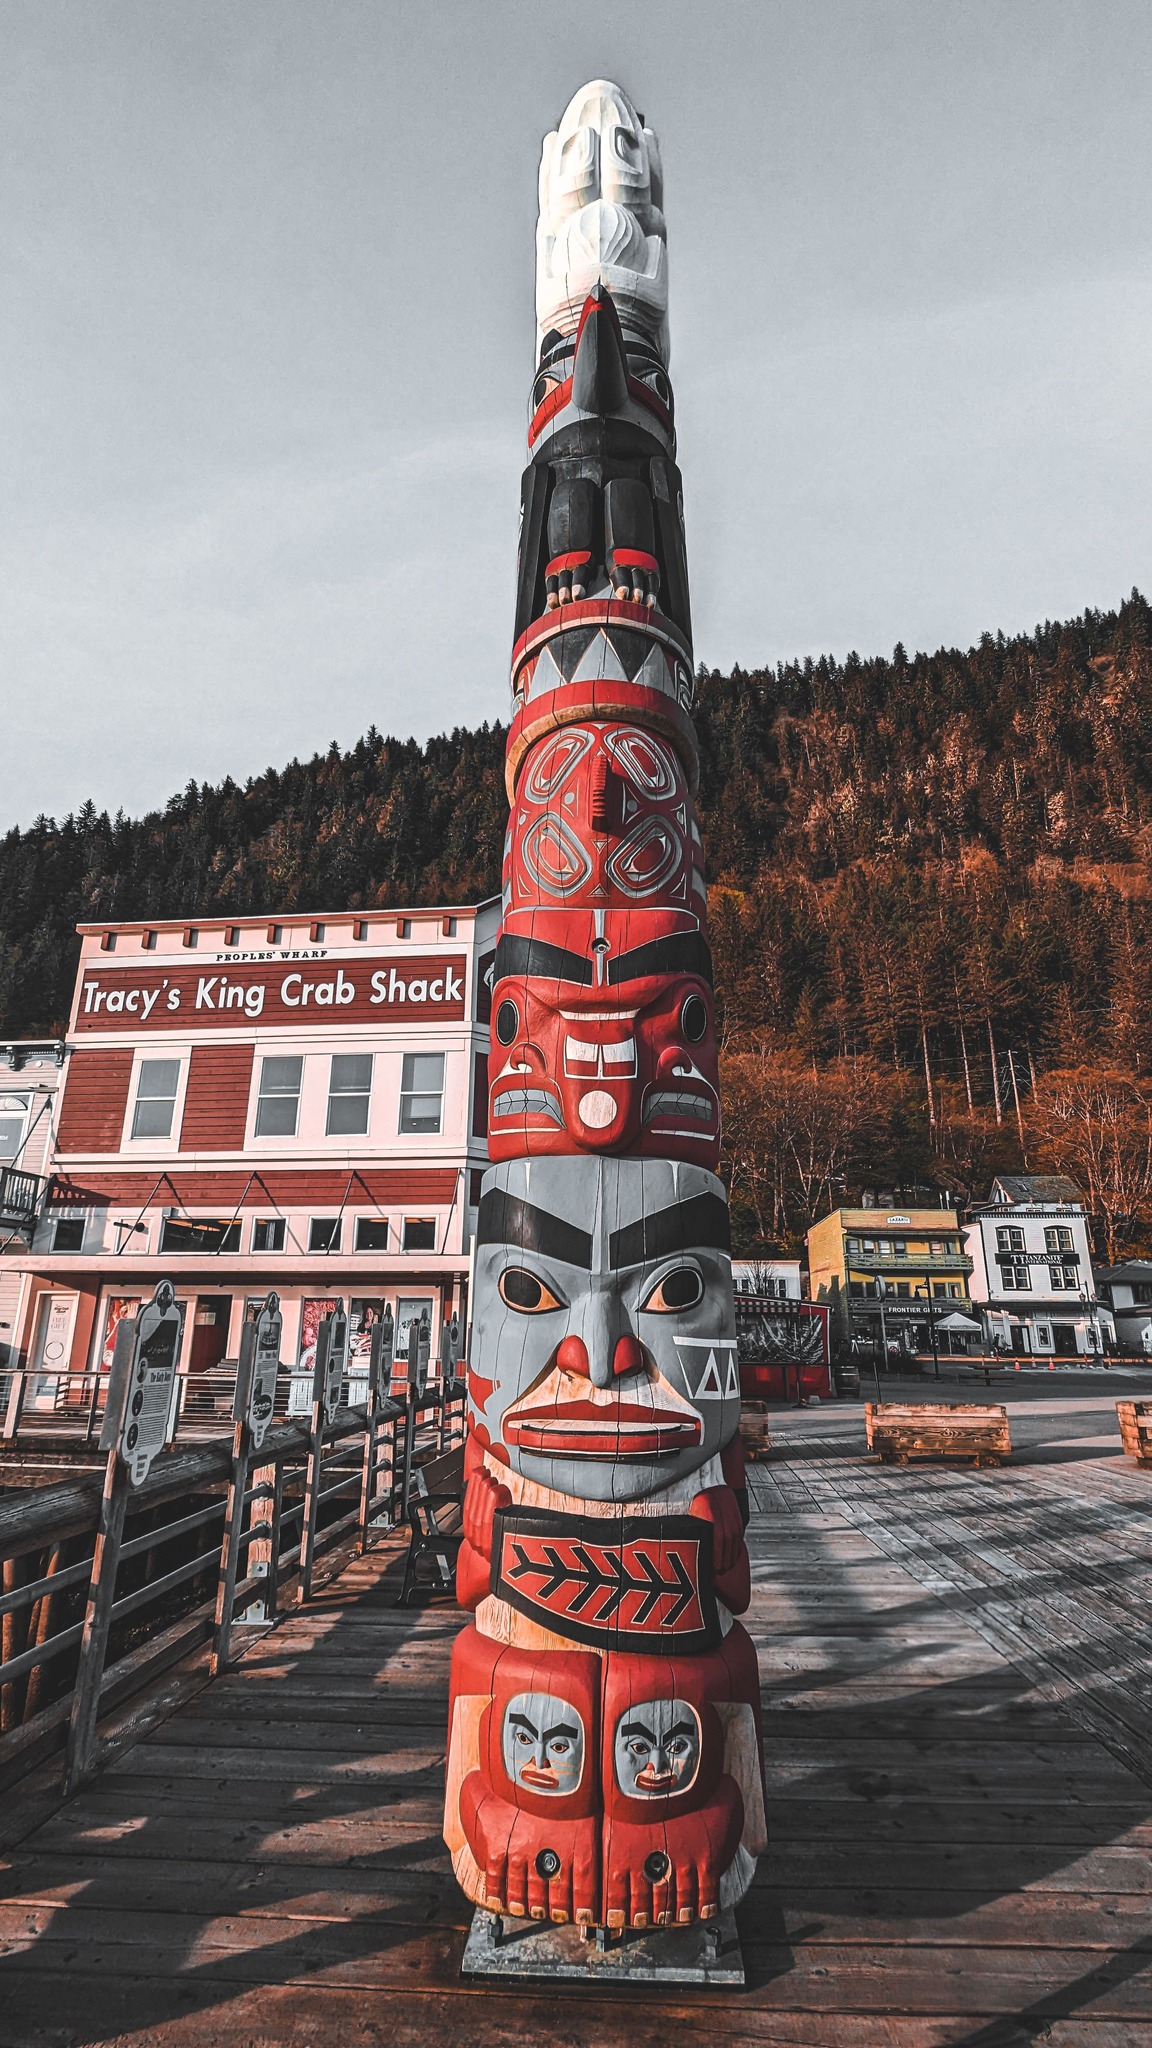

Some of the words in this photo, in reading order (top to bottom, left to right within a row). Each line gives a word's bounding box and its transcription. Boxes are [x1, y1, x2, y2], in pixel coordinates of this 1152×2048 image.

[216, 951, 276, 961] PEOPLES'
[280, 950, 328, 959] WHARF
[83, 979, 181, 1020] Tracy's
[195, 976, 266, 1018] King
[280, 969, 356, 1007] Crab
[369, 966, 464, 1004] Shack
